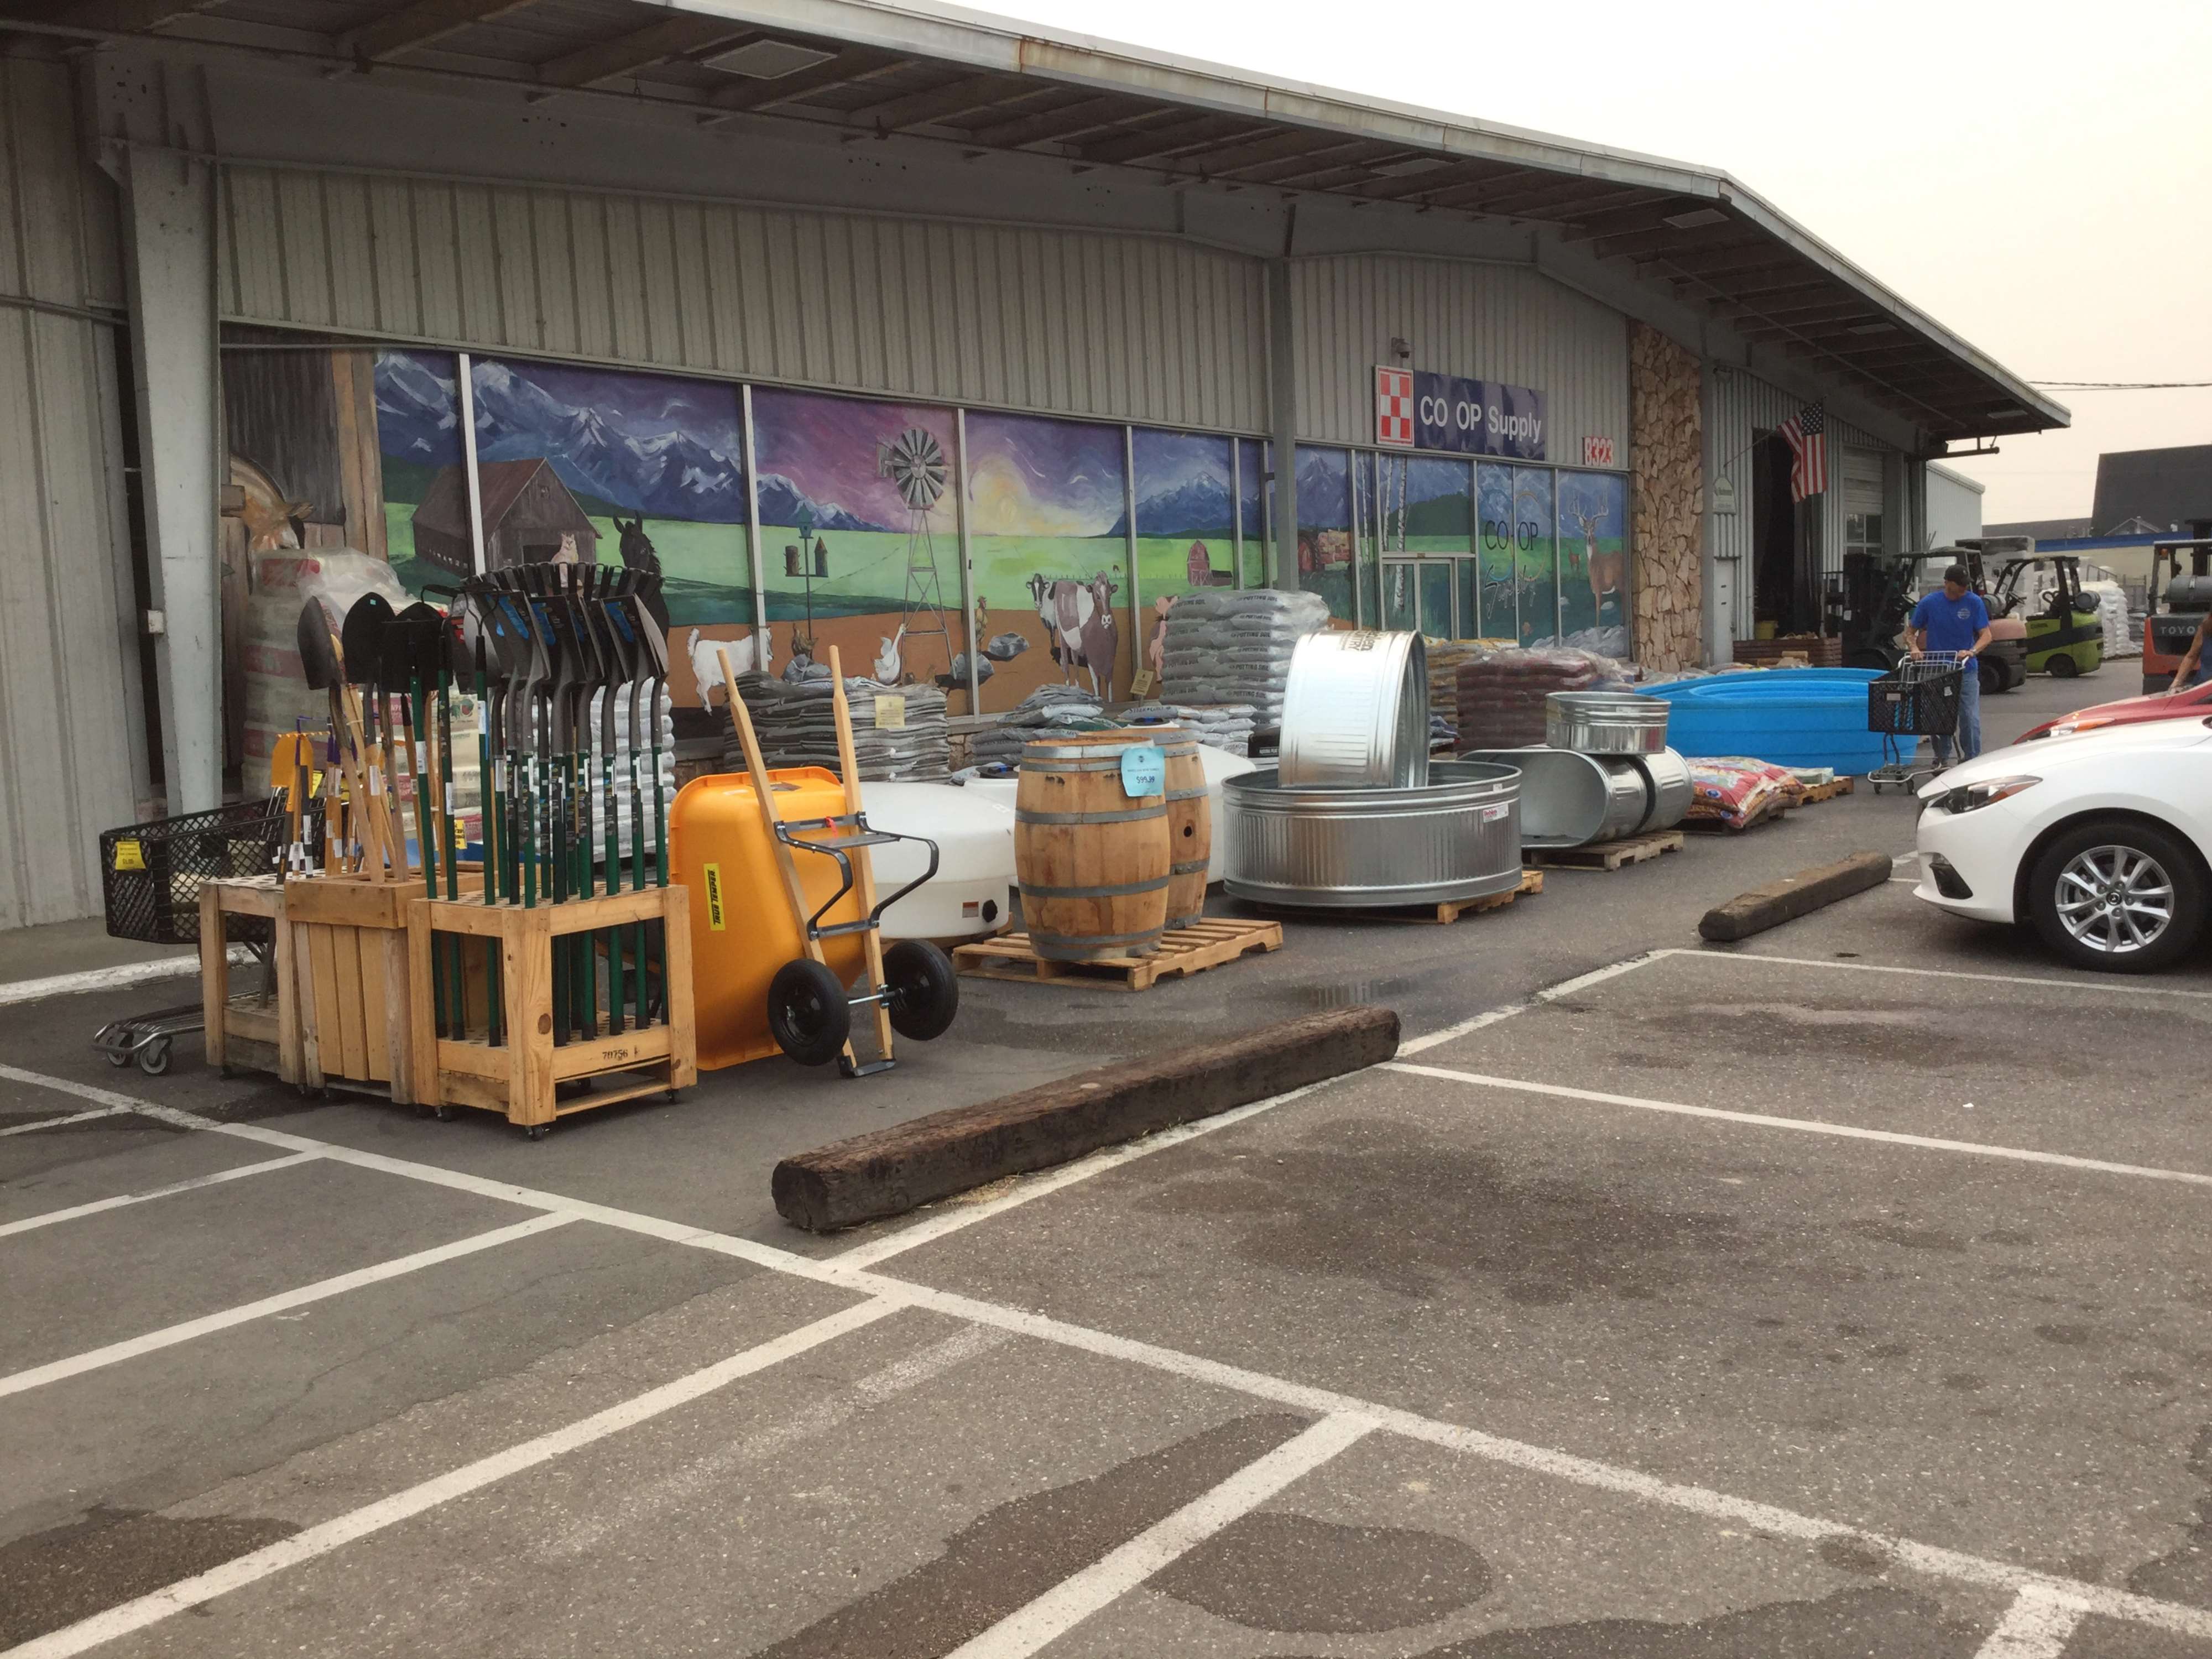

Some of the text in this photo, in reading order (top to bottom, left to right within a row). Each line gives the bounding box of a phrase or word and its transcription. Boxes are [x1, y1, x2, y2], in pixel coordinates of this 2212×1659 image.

[1420, 395, 1541, 444] CO OP Supply
[1584, 437, 1614, 467] 8323
[2160, 626, 2195, 635] TOYO
[708, 869, 721, 925] TRUE TEMPER
